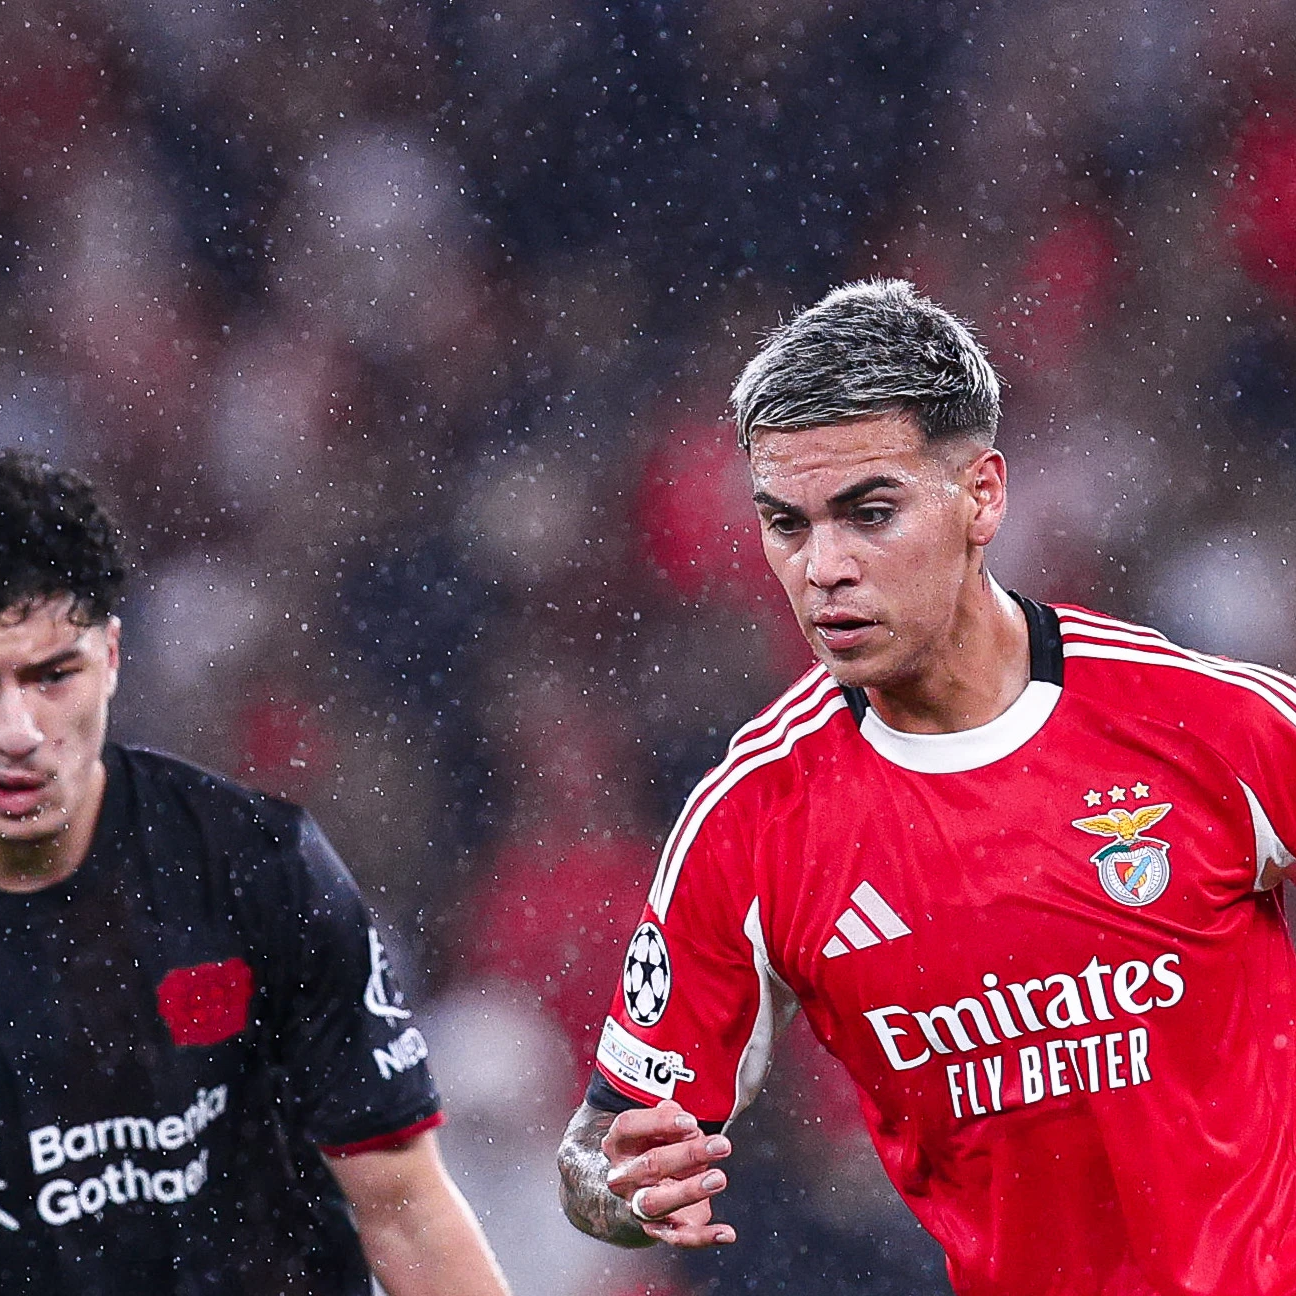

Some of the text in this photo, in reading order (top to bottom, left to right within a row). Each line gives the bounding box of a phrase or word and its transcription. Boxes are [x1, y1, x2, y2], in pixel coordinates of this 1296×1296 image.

[862, 952, 1186, 1072] Emirates
[945, 1026, 1152, 1119] FLY BETTER
